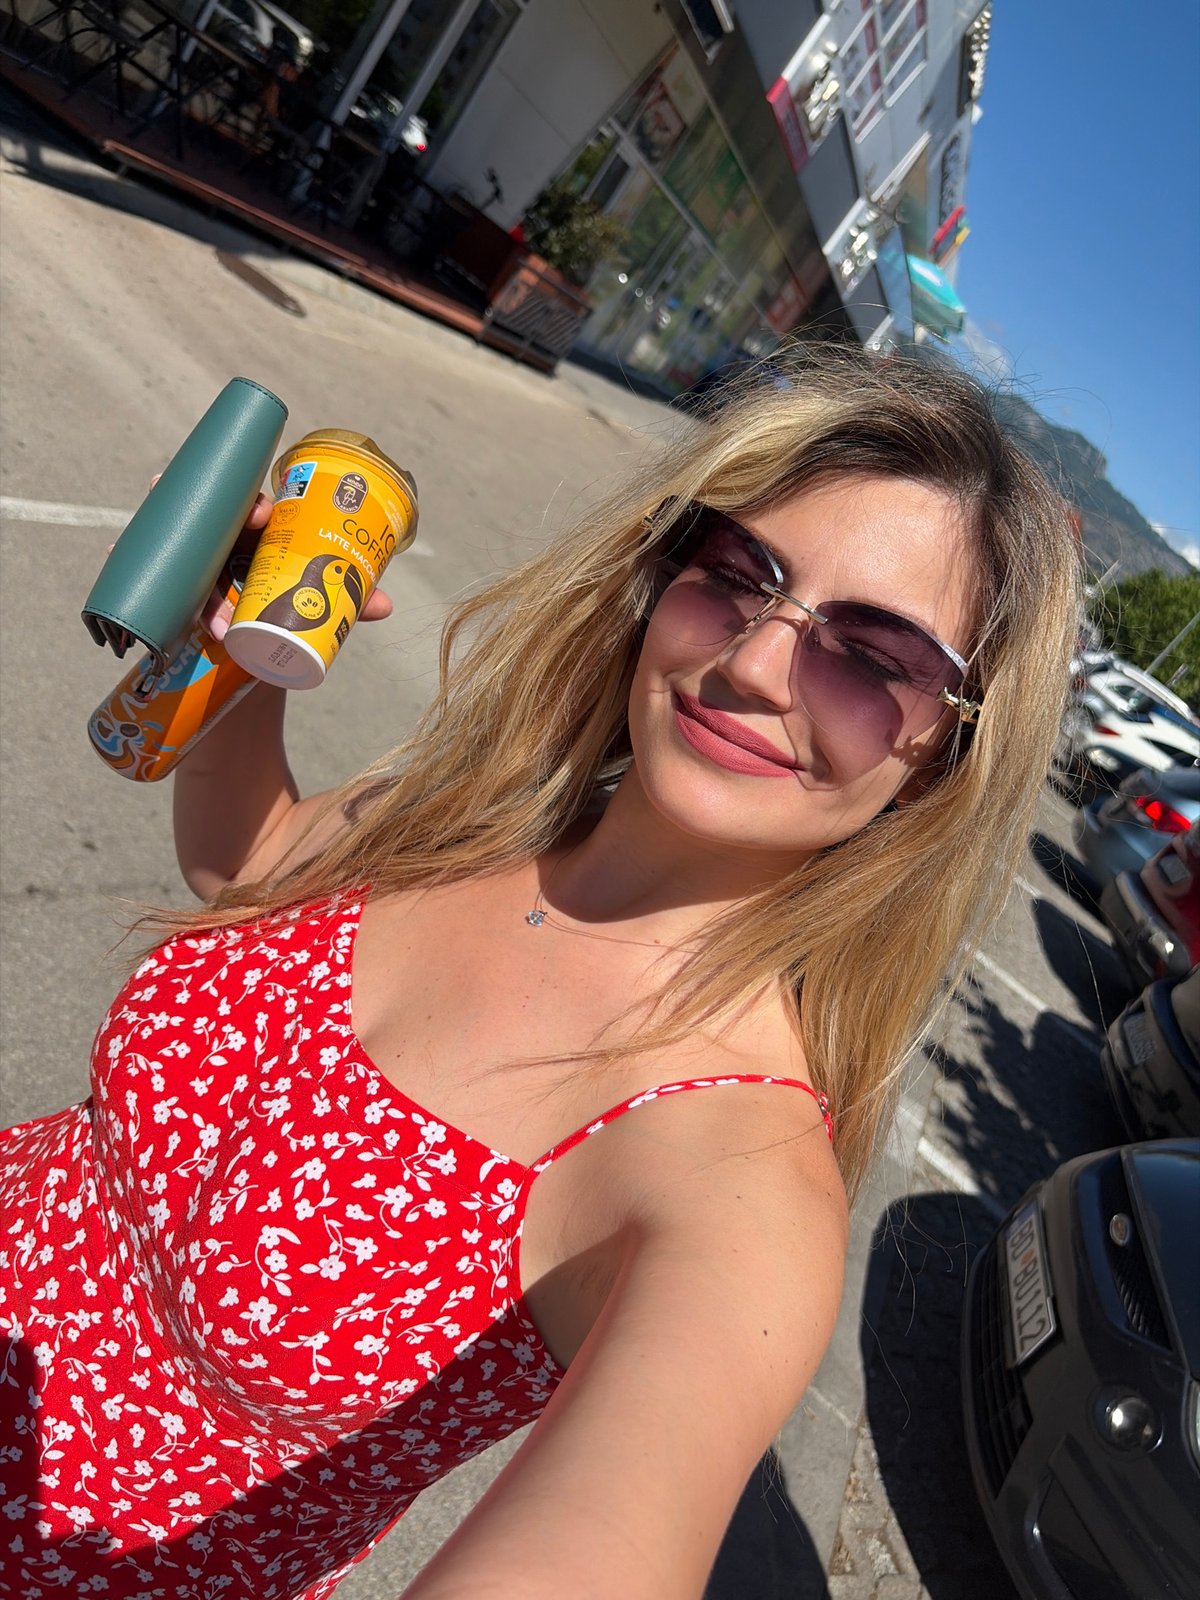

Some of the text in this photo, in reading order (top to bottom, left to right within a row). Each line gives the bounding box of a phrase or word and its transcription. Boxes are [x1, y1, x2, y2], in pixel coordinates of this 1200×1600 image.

[318, 527, 351, 551] LATTE
[342, 519, 387, 574] COFFE
[380, 524, 396, 555] IC
